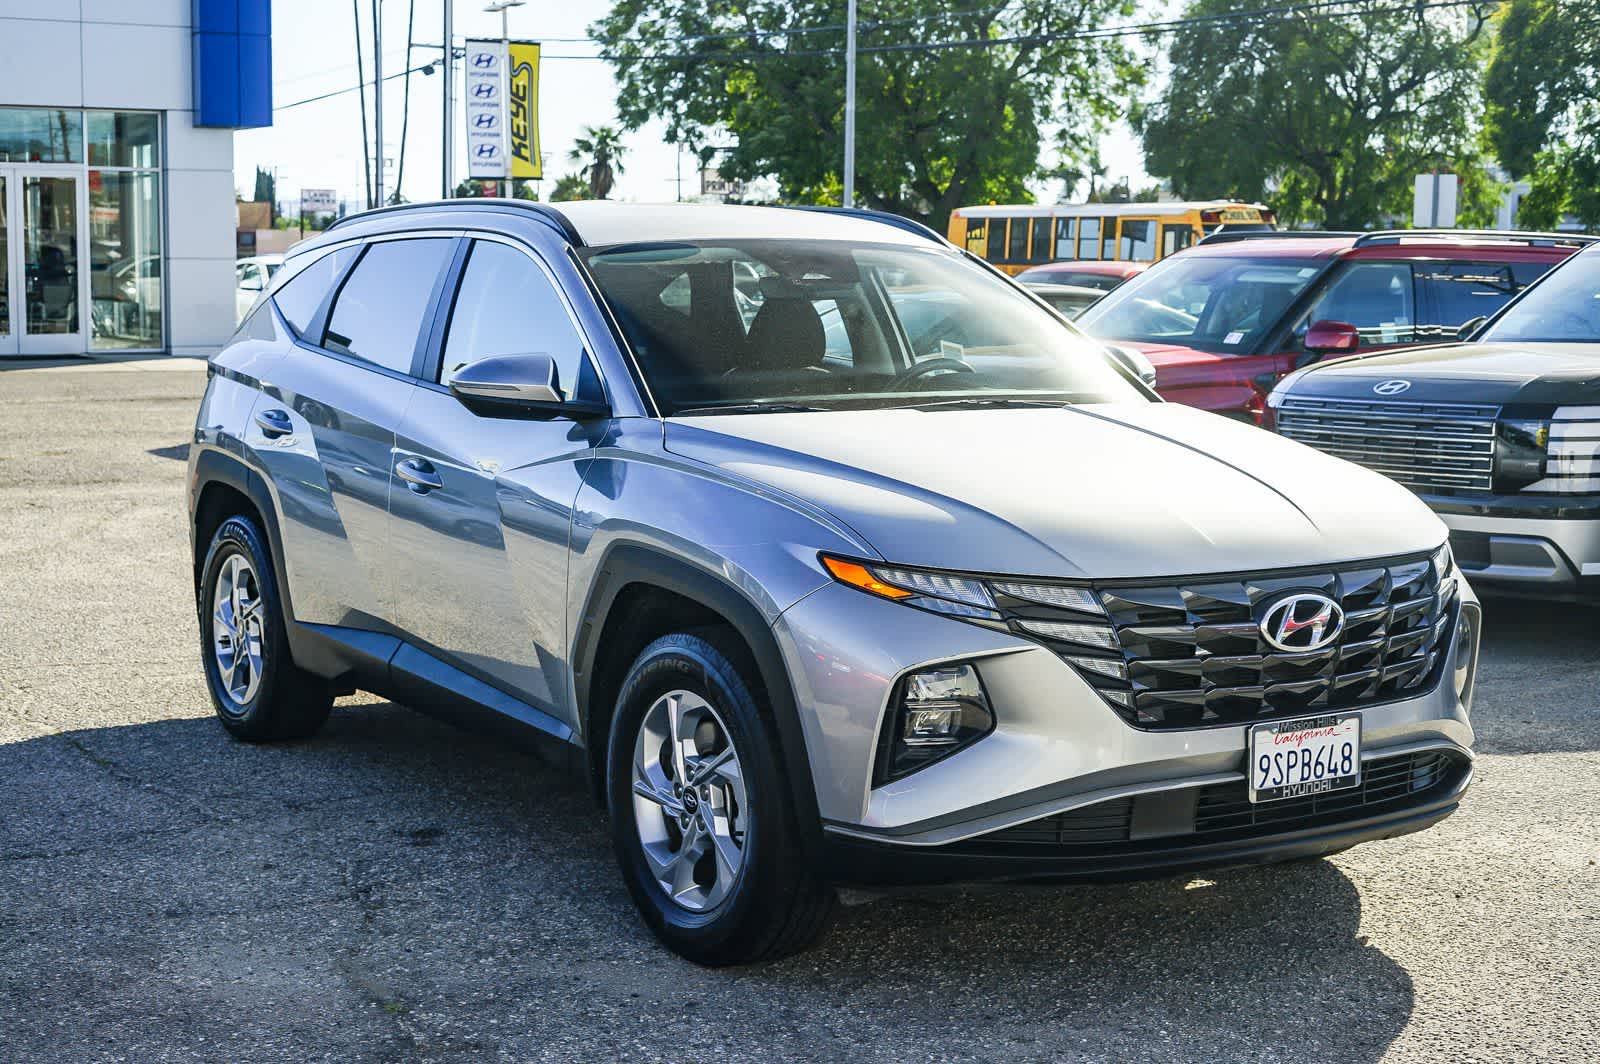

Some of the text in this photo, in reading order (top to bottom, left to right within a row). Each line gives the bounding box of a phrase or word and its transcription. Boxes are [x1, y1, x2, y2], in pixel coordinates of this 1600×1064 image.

[509, 54, 534, 162] KEYES
[1223, 211, 1245, 220] SCHOOL
[1280, 717, 1335, 732] Mission Hills
[1274, 727, 1341, 747] California
[1259, 742, 1353, 788] 9SPB648
[1282, 780, 1331, 797] HYUNDAI
